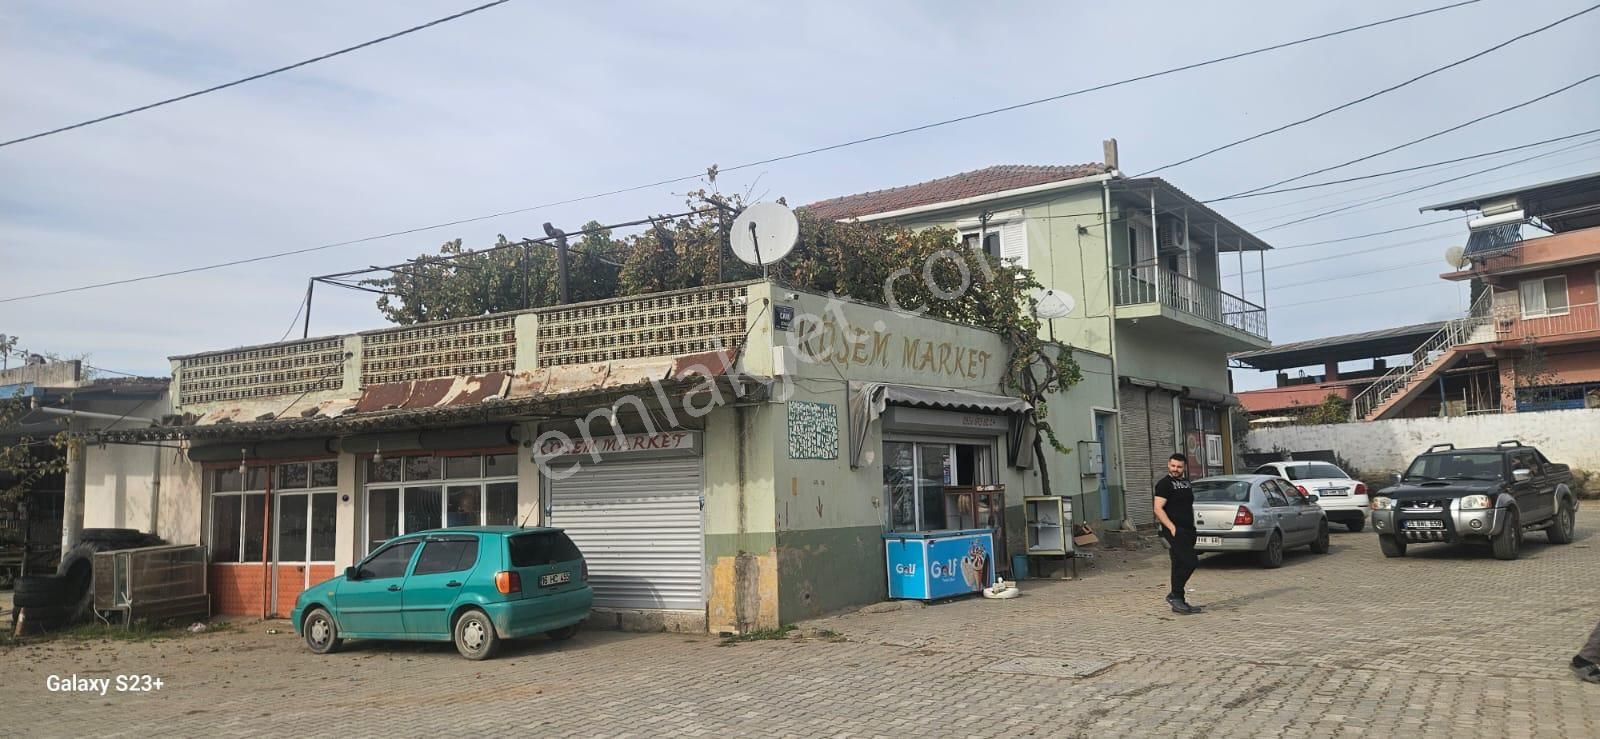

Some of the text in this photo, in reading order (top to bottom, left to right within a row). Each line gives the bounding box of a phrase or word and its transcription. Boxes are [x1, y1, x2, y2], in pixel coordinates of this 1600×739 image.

[902, 336, 992, 379] MARKET
[602, 432, 688, 451] MARKET
[895, 563, 916, 575] Golf
[930, 558, 958, 578] Golf
